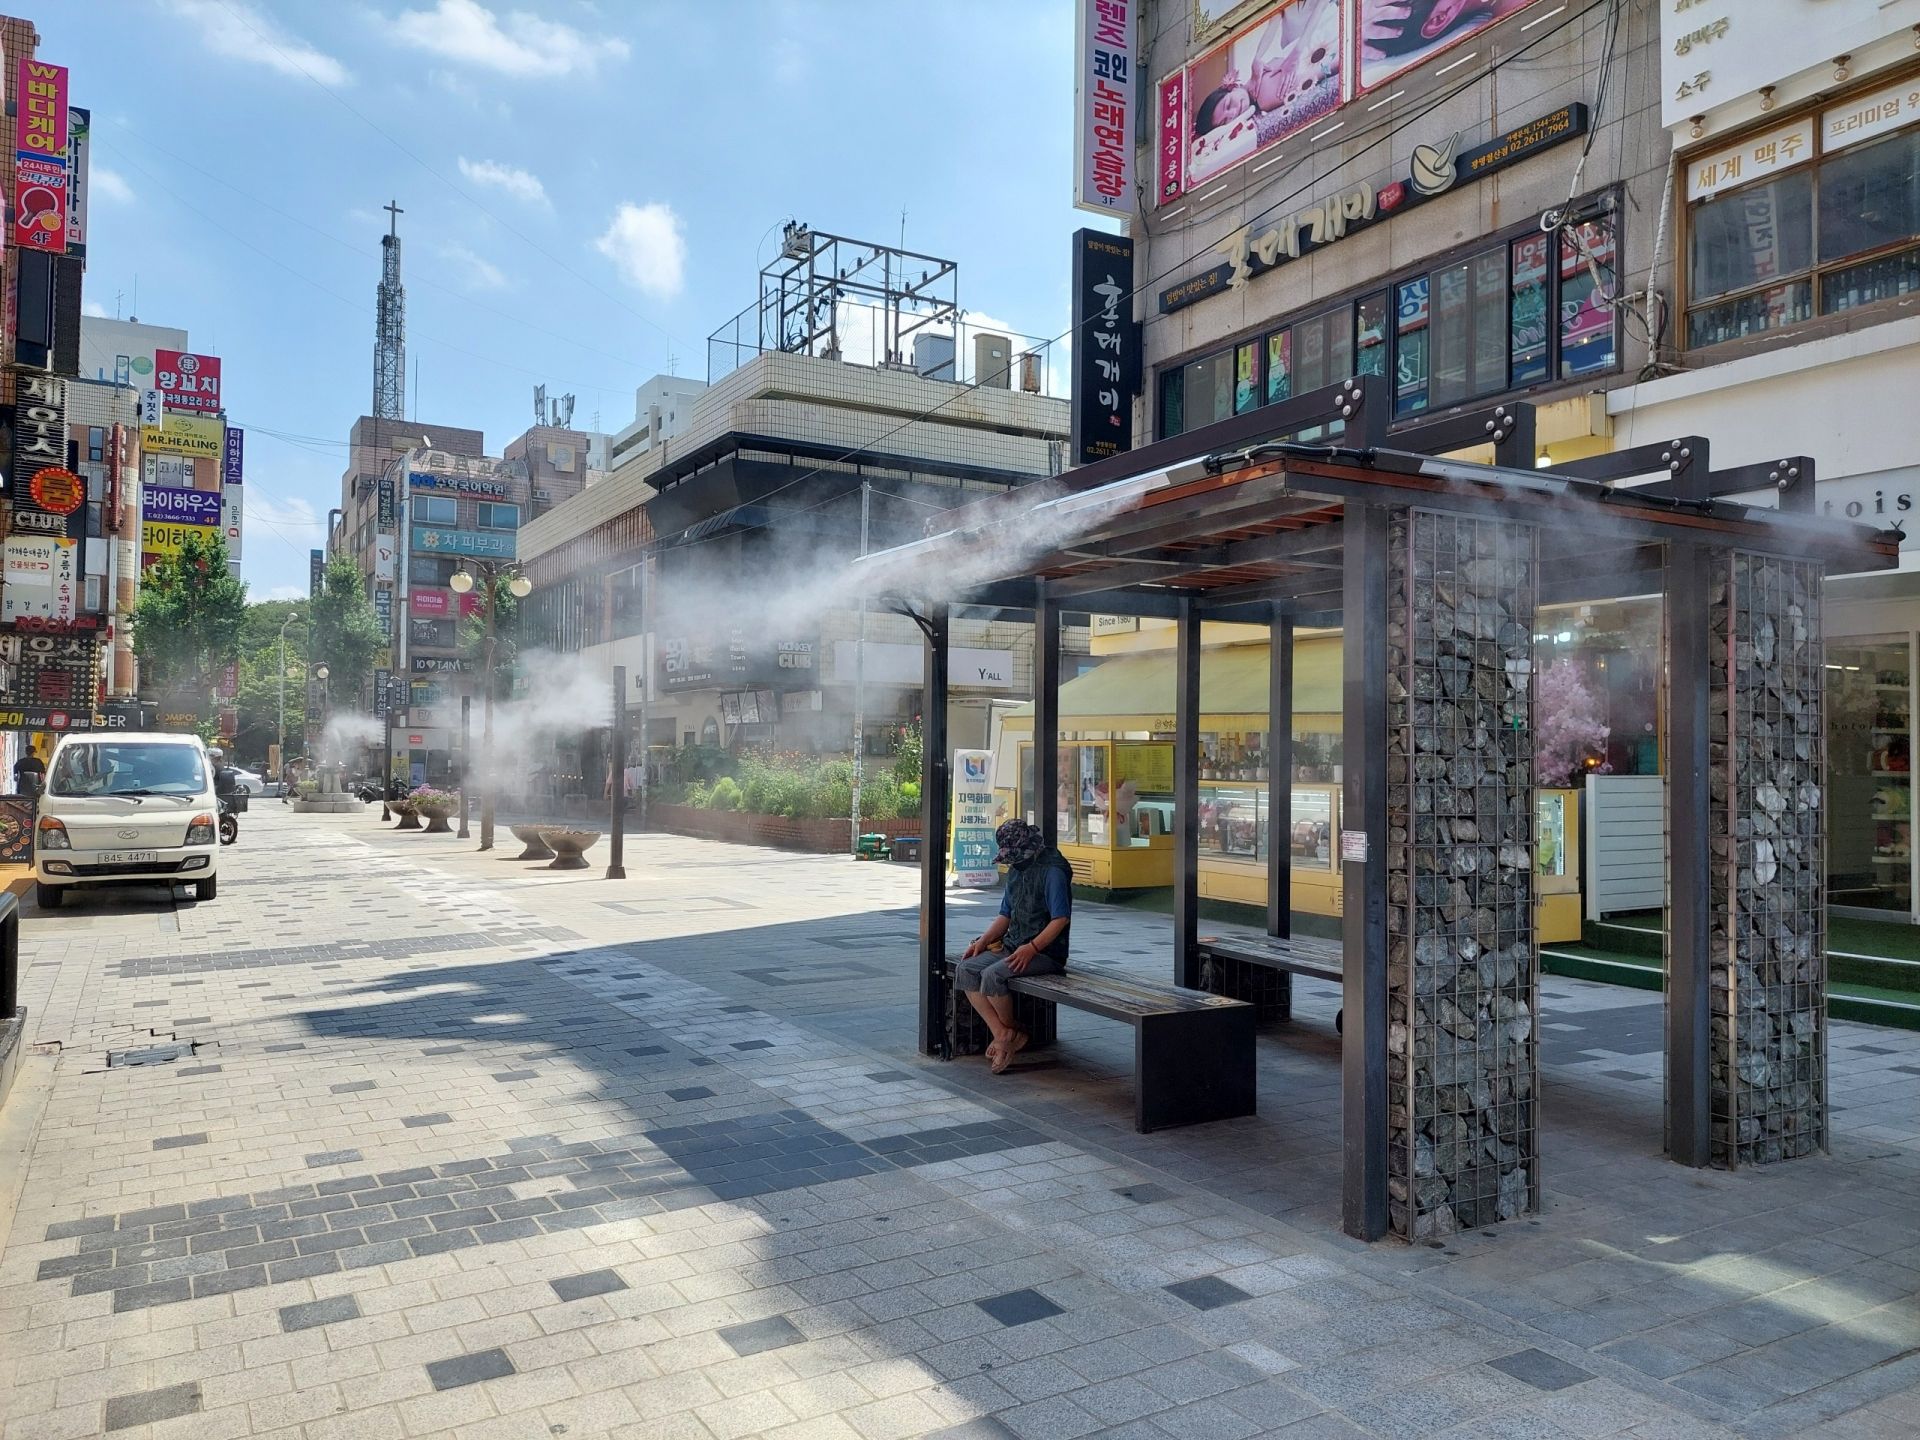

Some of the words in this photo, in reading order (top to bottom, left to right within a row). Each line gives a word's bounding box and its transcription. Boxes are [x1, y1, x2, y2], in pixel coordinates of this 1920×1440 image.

[1674, 16, 1731, 56] 생맥주
[1093, 49, 1127, 84] 코인
[1676, 69, 1712, 101] 소주
[1533, 110, 1569, 130] 1544-9276
[1830, 98, 1901, 138] 프리미엄
[1092, 79, 1127, 198] 노래연습장
[1510, 119, 1569, 152] 02.2611.7964
[1697, 155, 1742, 190] 세계
[1755, 132, 1804, 165] 맥주
[1102, 196, 1116, 206] 3F
[31, 231, 52, 244] 4F
[1215, 181, 1377, 292] 홍대개미
[1093, 273, 1123, 412] 홍대개미
[158, 371, 218, 395] 양꼬치
[146, 391, 157, 423] 주짓수
[162, 393, 203, 407] 국정통요리
[146, 434, 218, 450] MR.HEALING
[228, 429, 241, 475] 타이하우스
[143, 490, 219, 513] 타이하우스
[59, 550, 71, 581] 구름산
[1098, 617, 1116, 627] Since
[778, 653, 813, 668] CLUB
[978, 667, 1003, 681] Y'ALL
[127, 852, 151, 861] 4471
